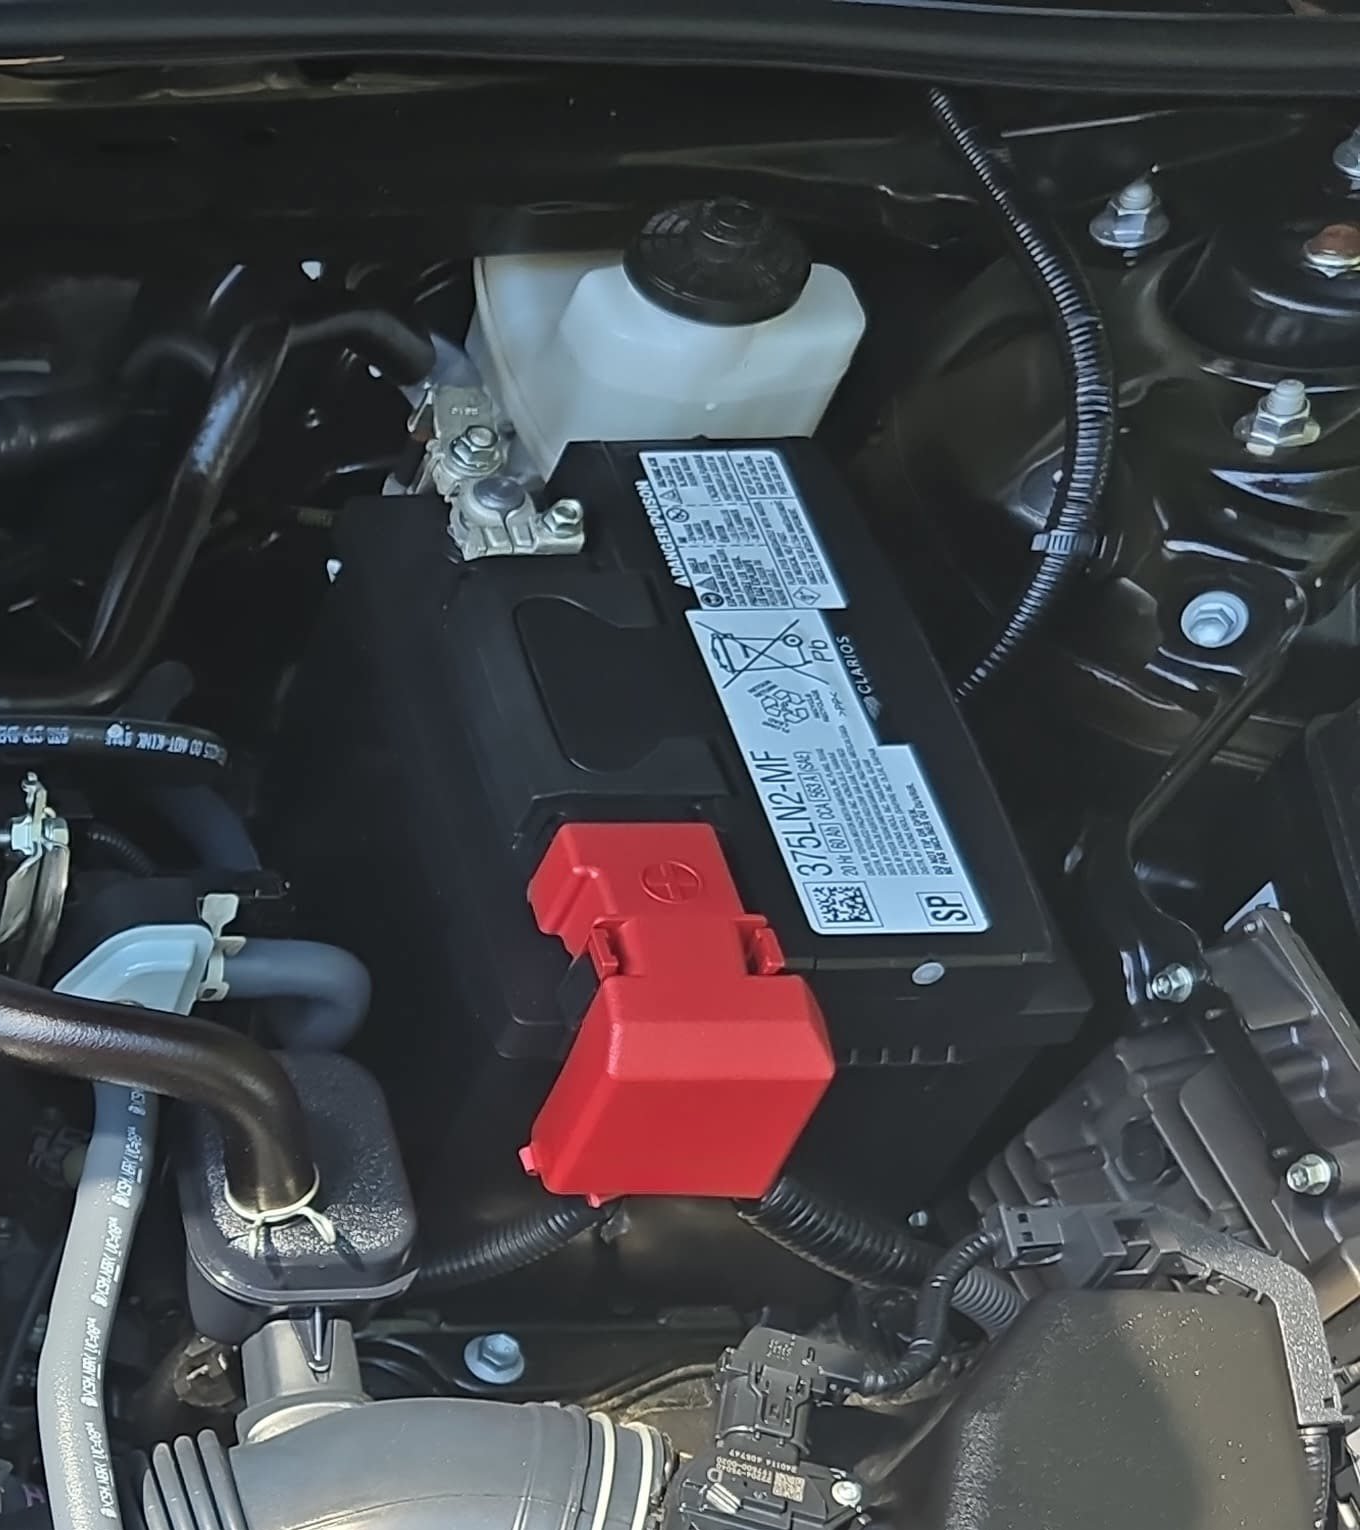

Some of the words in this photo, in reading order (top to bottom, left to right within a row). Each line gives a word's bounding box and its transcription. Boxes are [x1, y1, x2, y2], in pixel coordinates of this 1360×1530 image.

[635, 480, 687, 573] DANGER/POISON
[805, 639, 835, 662] Pb
[834, 635, 874, 694] CLARIOS
[748, 750, 835, 876] 375LN2-MF
[835, 854, 854, 864] Hr
[840, 865, 859, 875] 20
[923, 895, 968, 920] SP
